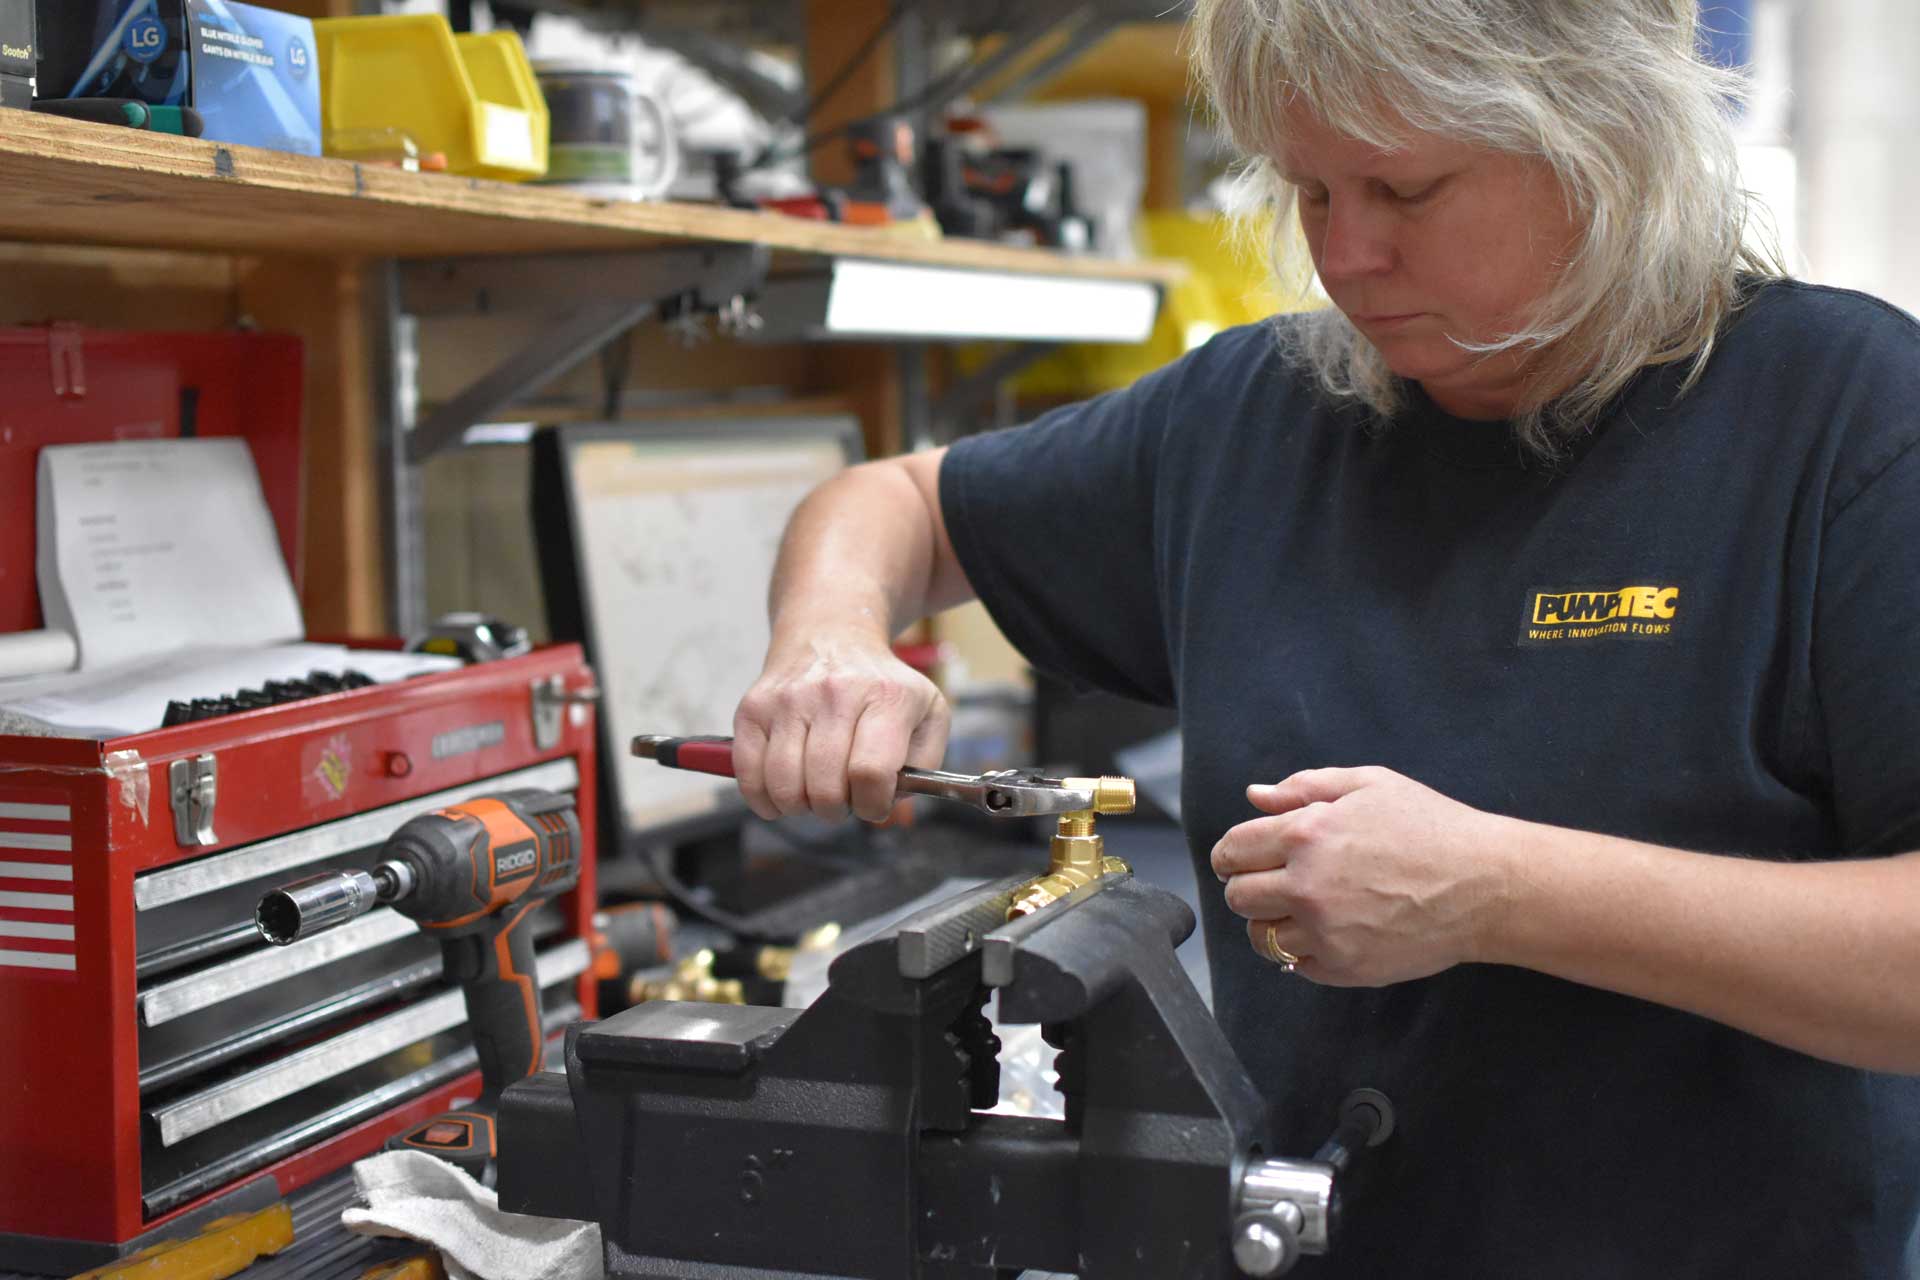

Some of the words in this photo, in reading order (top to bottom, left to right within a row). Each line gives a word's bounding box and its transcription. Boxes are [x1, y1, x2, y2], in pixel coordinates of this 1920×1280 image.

[131, 26, 160, 48] LG
[2, 44, 29, 60] Scotch
[289, 47, 306, 65] LG
[1534, 586, 1679, 623] PUMPTEC
[1529, 629, 1564, 640] WHERE
[1568, 622, 1627, 639] INNOVATION
[1632, 623, 1671, 635] FLOWS
[496, 849, 535, 873] RIDGID
